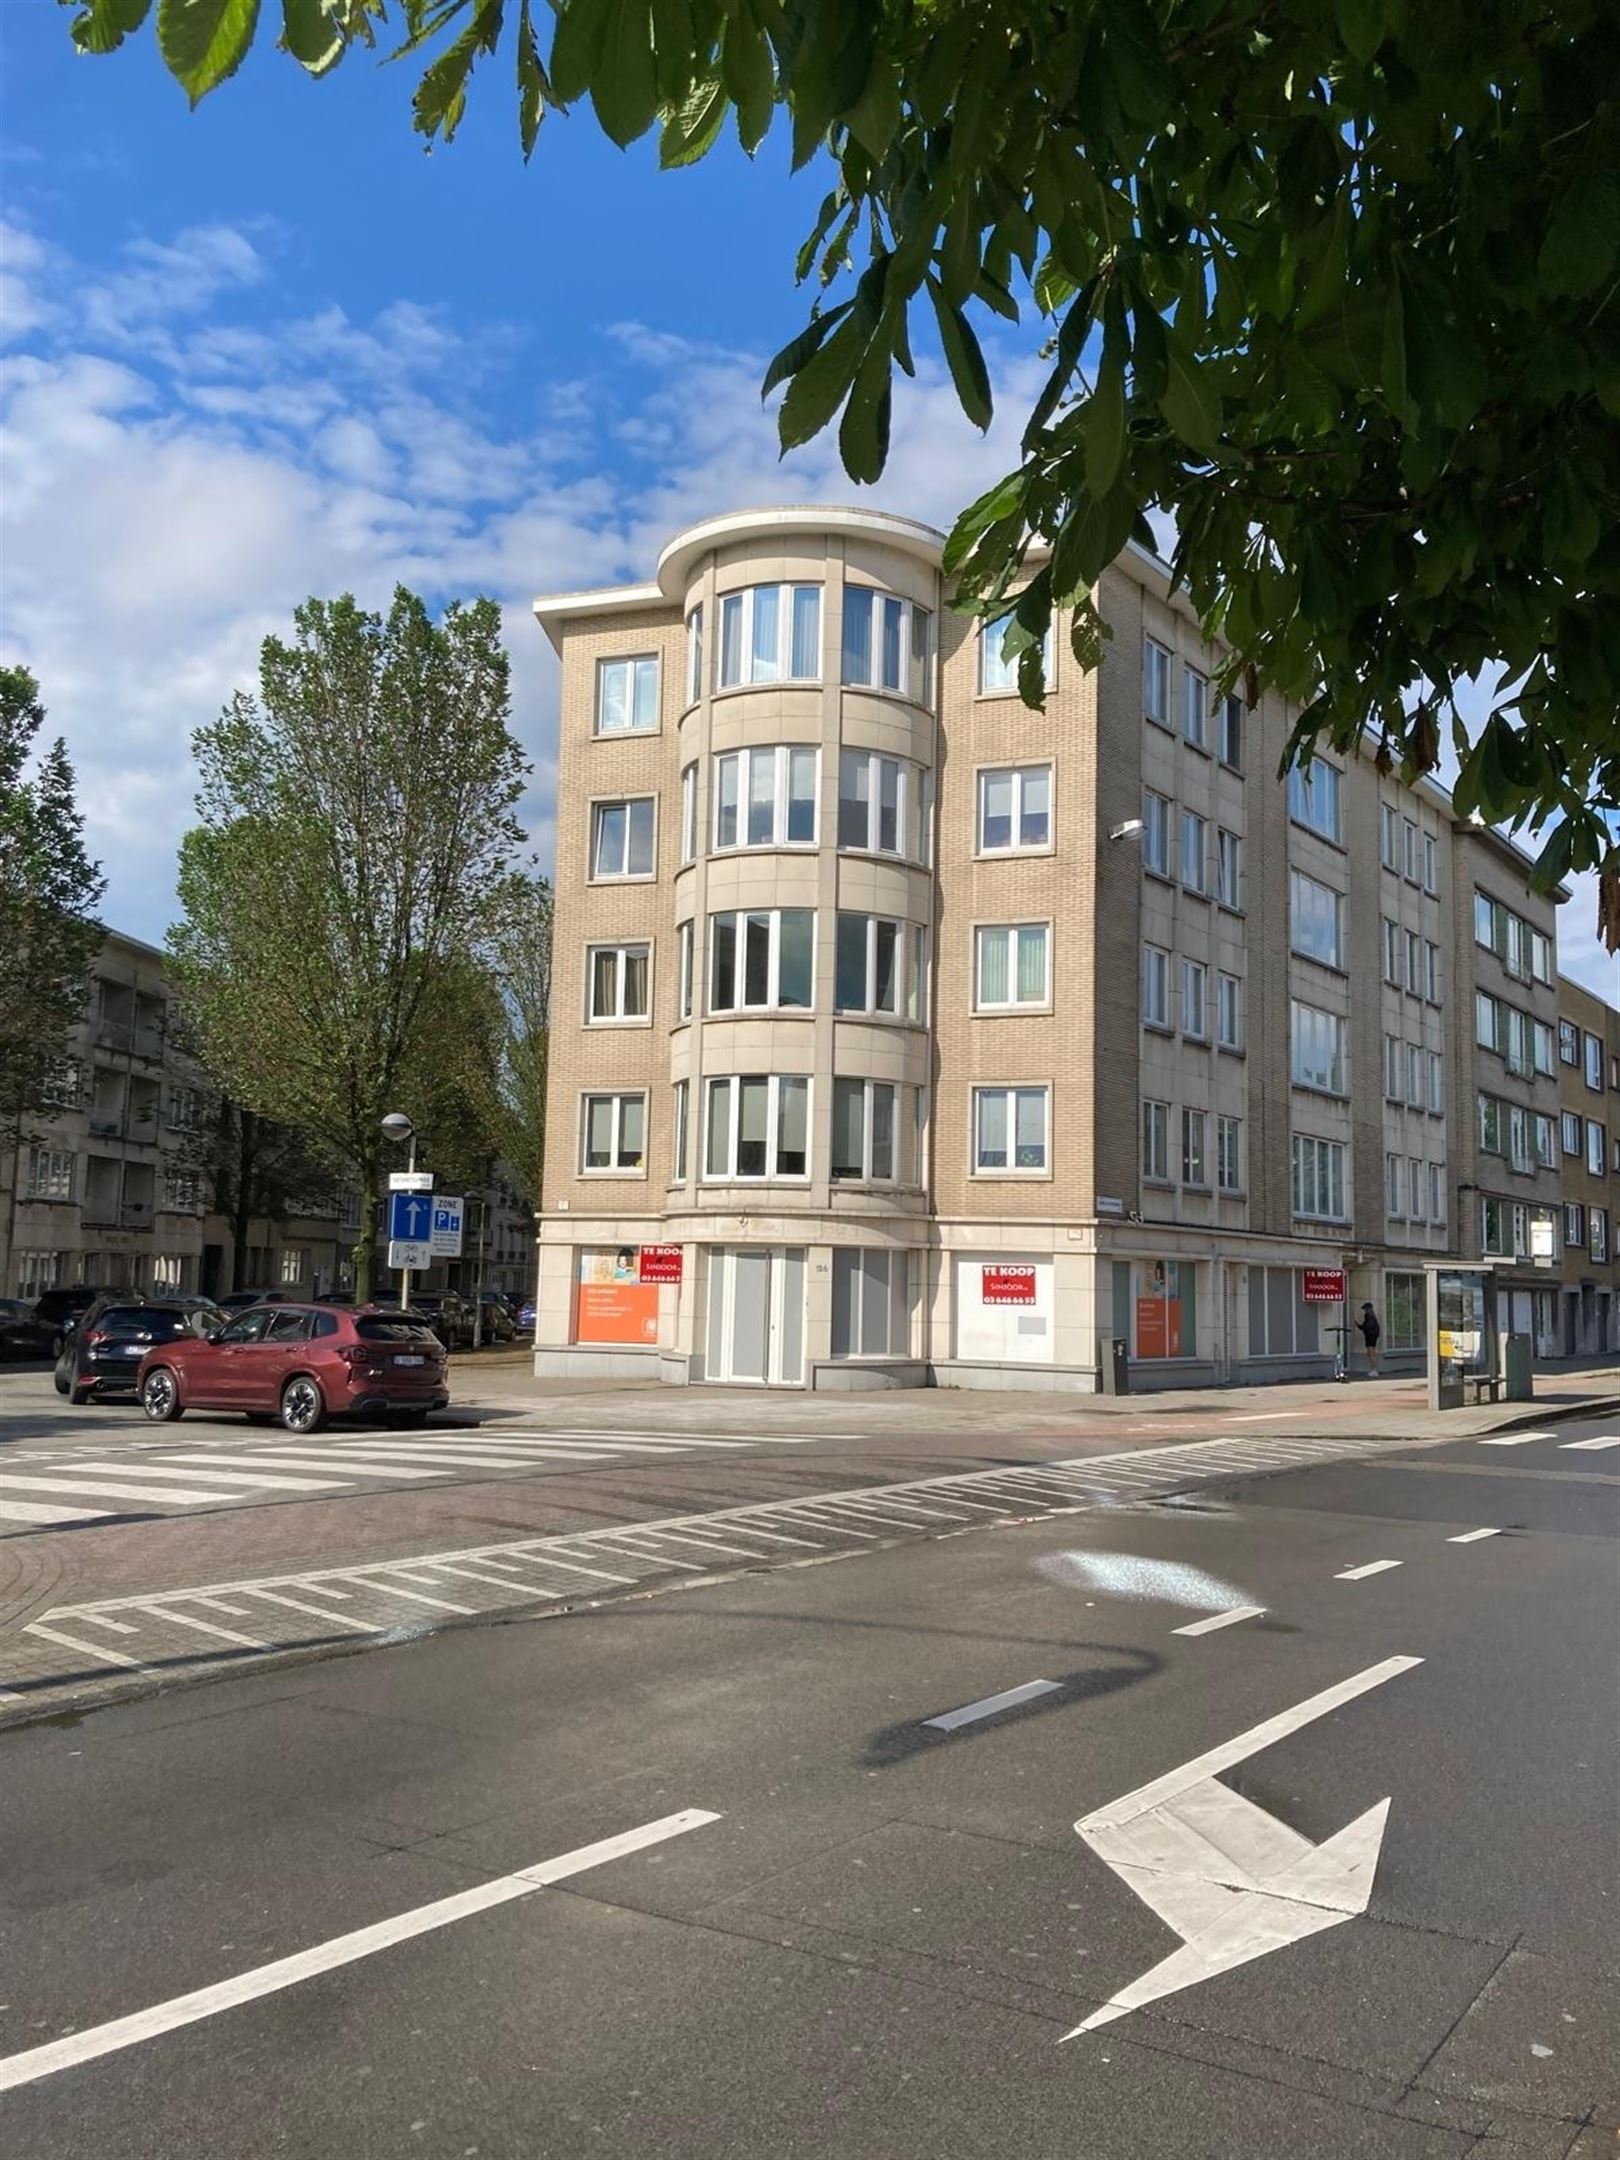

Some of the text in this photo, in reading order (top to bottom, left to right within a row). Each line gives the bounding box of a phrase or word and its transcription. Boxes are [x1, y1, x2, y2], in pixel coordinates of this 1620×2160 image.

[439, 1200, 457, 1208] ZONE
[438, 1212, 446, 1226] P
[643, 1247, 654, 1255] TE
[984, 1267, 1034, 1276] TE KOOP
